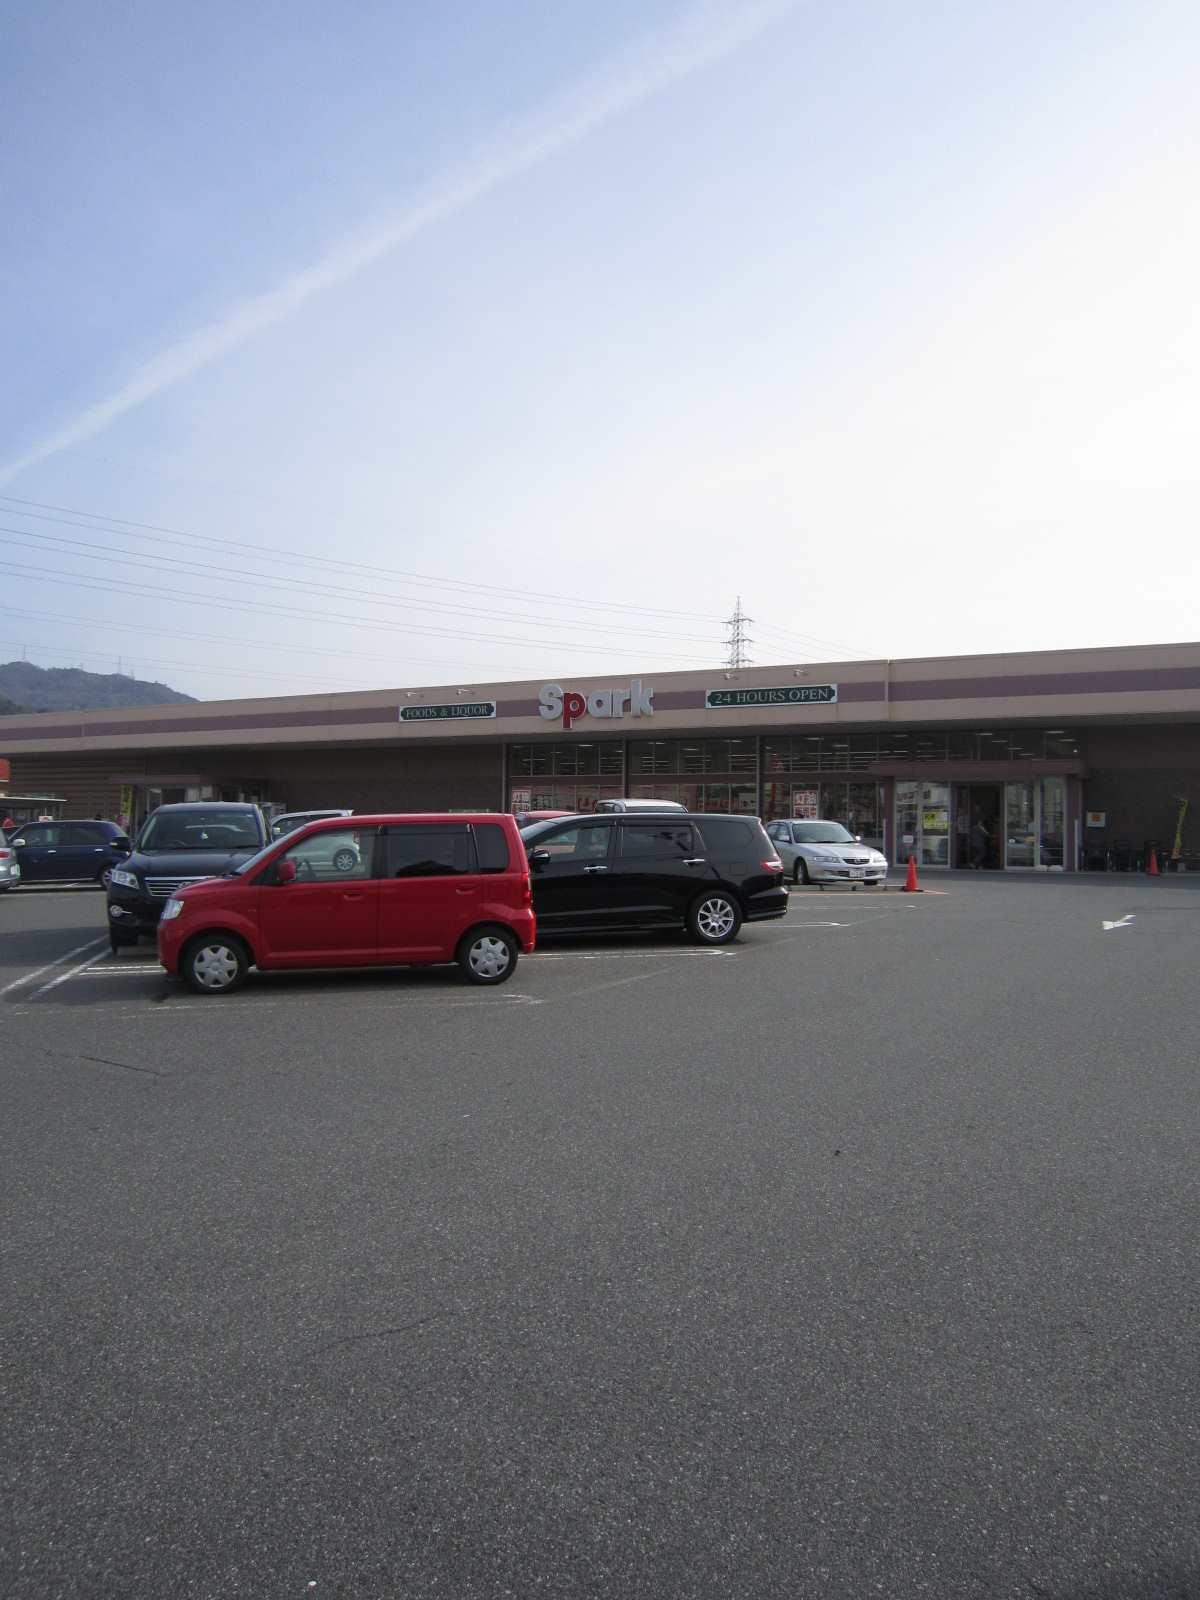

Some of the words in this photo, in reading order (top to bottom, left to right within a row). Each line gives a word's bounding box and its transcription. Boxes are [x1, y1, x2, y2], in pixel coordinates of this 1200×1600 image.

[715, 692, 732, 704] 24
[736, 690, 785, 703] HOURS
[789, 688, 829, 701] OPEN
[538, 679, 654, 729] Spark
[406, 708, 437, 719] FOODS
[440, 707, 448, 717] &
[451, 705, 488, 717] LIQUOR
[795, 792, 817, 805] 灯油
